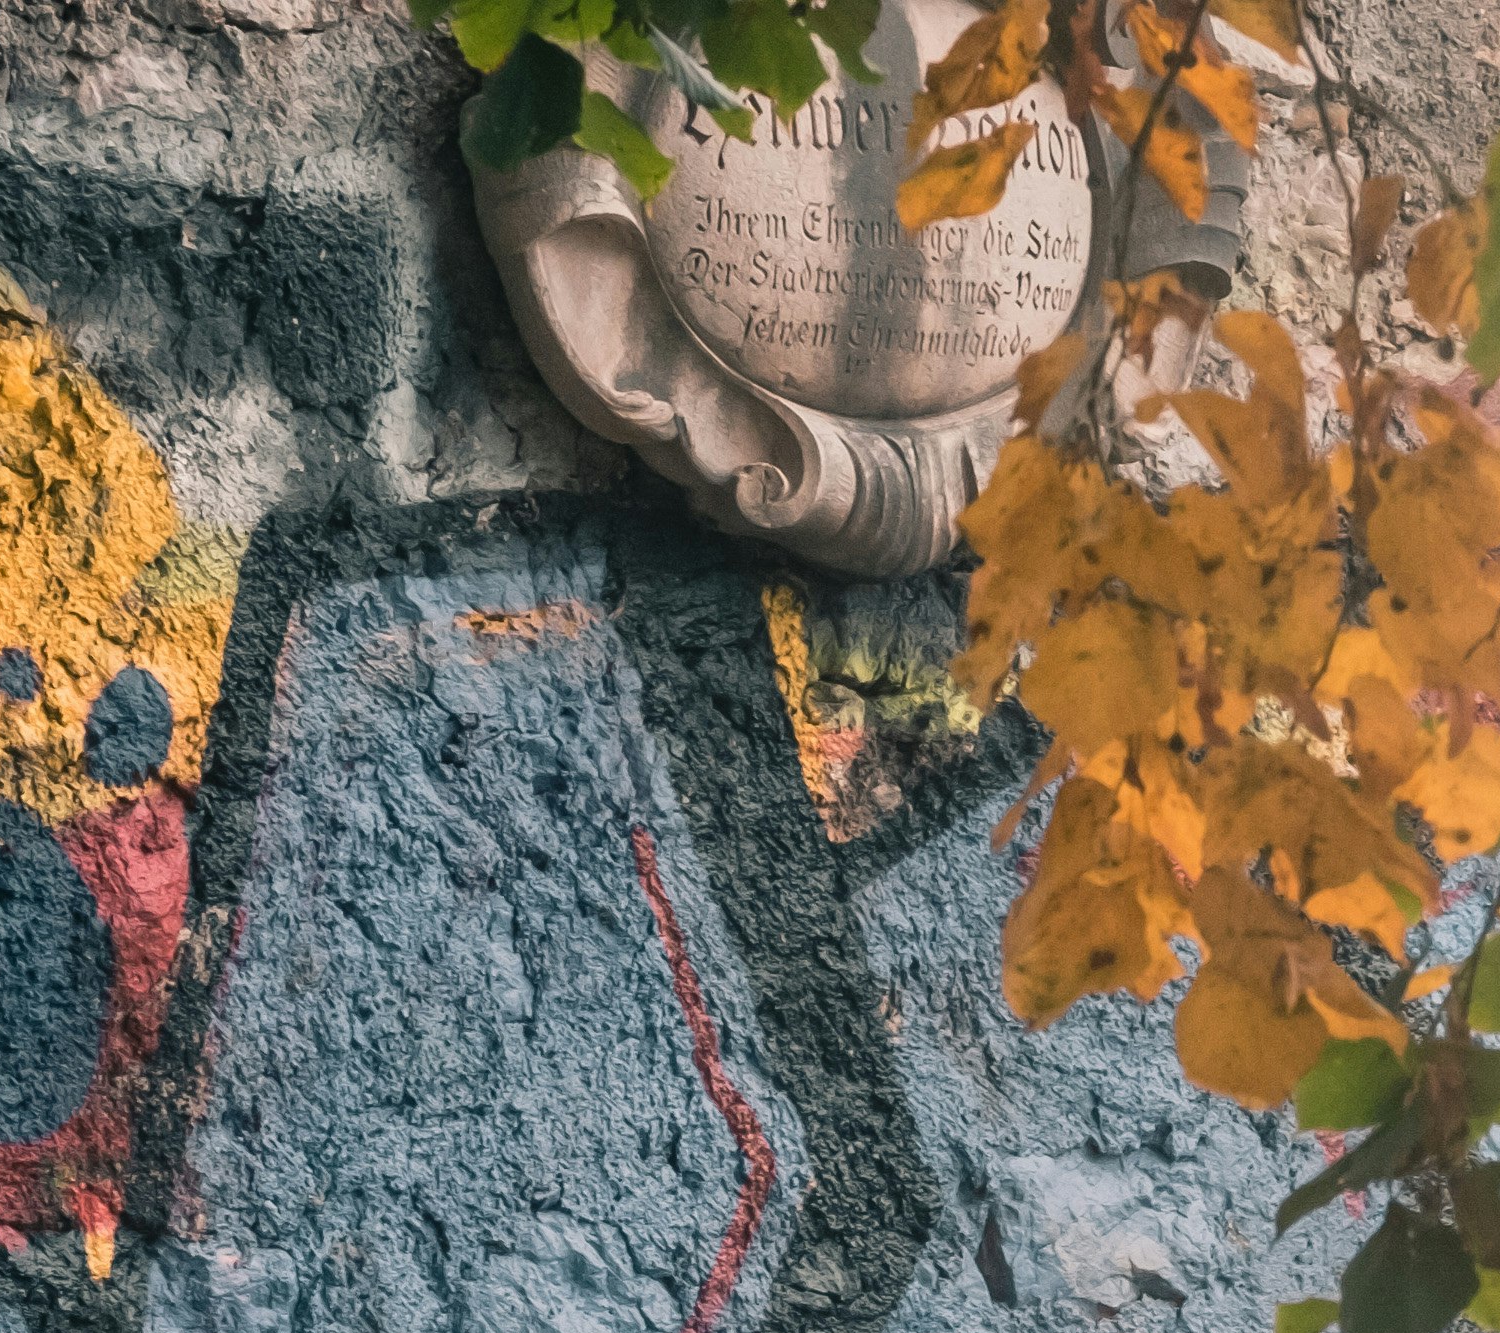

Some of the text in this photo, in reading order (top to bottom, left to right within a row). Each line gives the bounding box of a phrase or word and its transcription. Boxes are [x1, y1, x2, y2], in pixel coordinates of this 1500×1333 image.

[694, 194, 788, 246] Ihrem
[802, 201, 968, 262] Ehrenbrger
[983, 215, 1016, 256] die
[682, 246, 738, 287] Der
